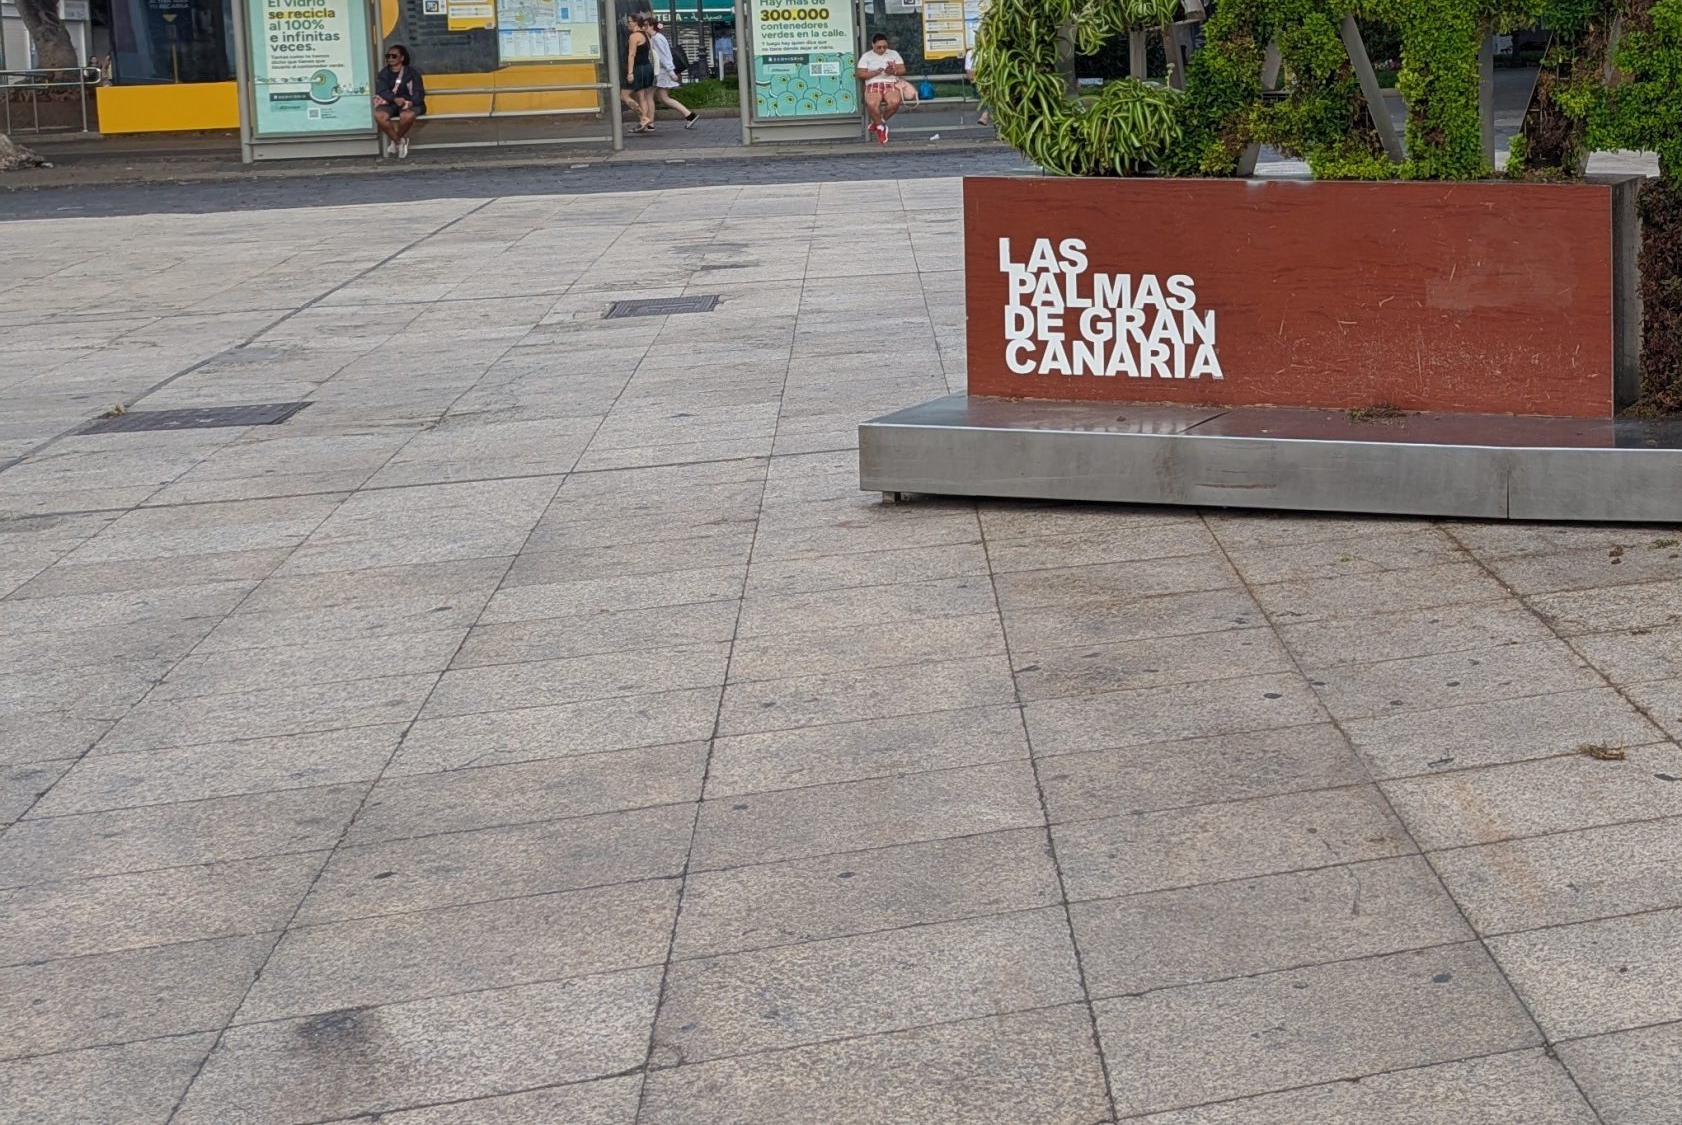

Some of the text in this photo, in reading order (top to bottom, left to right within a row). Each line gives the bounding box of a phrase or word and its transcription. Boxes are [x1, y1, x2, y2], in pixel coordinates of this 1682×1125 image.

[268, 7, 336, 19] se recicla
[760, 8, 830, 22] 300.000
[269, 19, 325, 31] al 100%
[760, 21, 829, 31] contenedores
[270, 31, 340, 43] e infinitas
[761, 30, 795, 39] verdes
[811, 30, 819, 38] la
[822, 28, 847, 38] calle.
[270, 43, 316, 52] veces.
[999, 237, 1088, 274] LAS
[1009, 272, 1197, 311] PALMAS
[1004, 304, 1216, 345] DE GRAN
[1005, 339, 1224, 379] CANARIA
